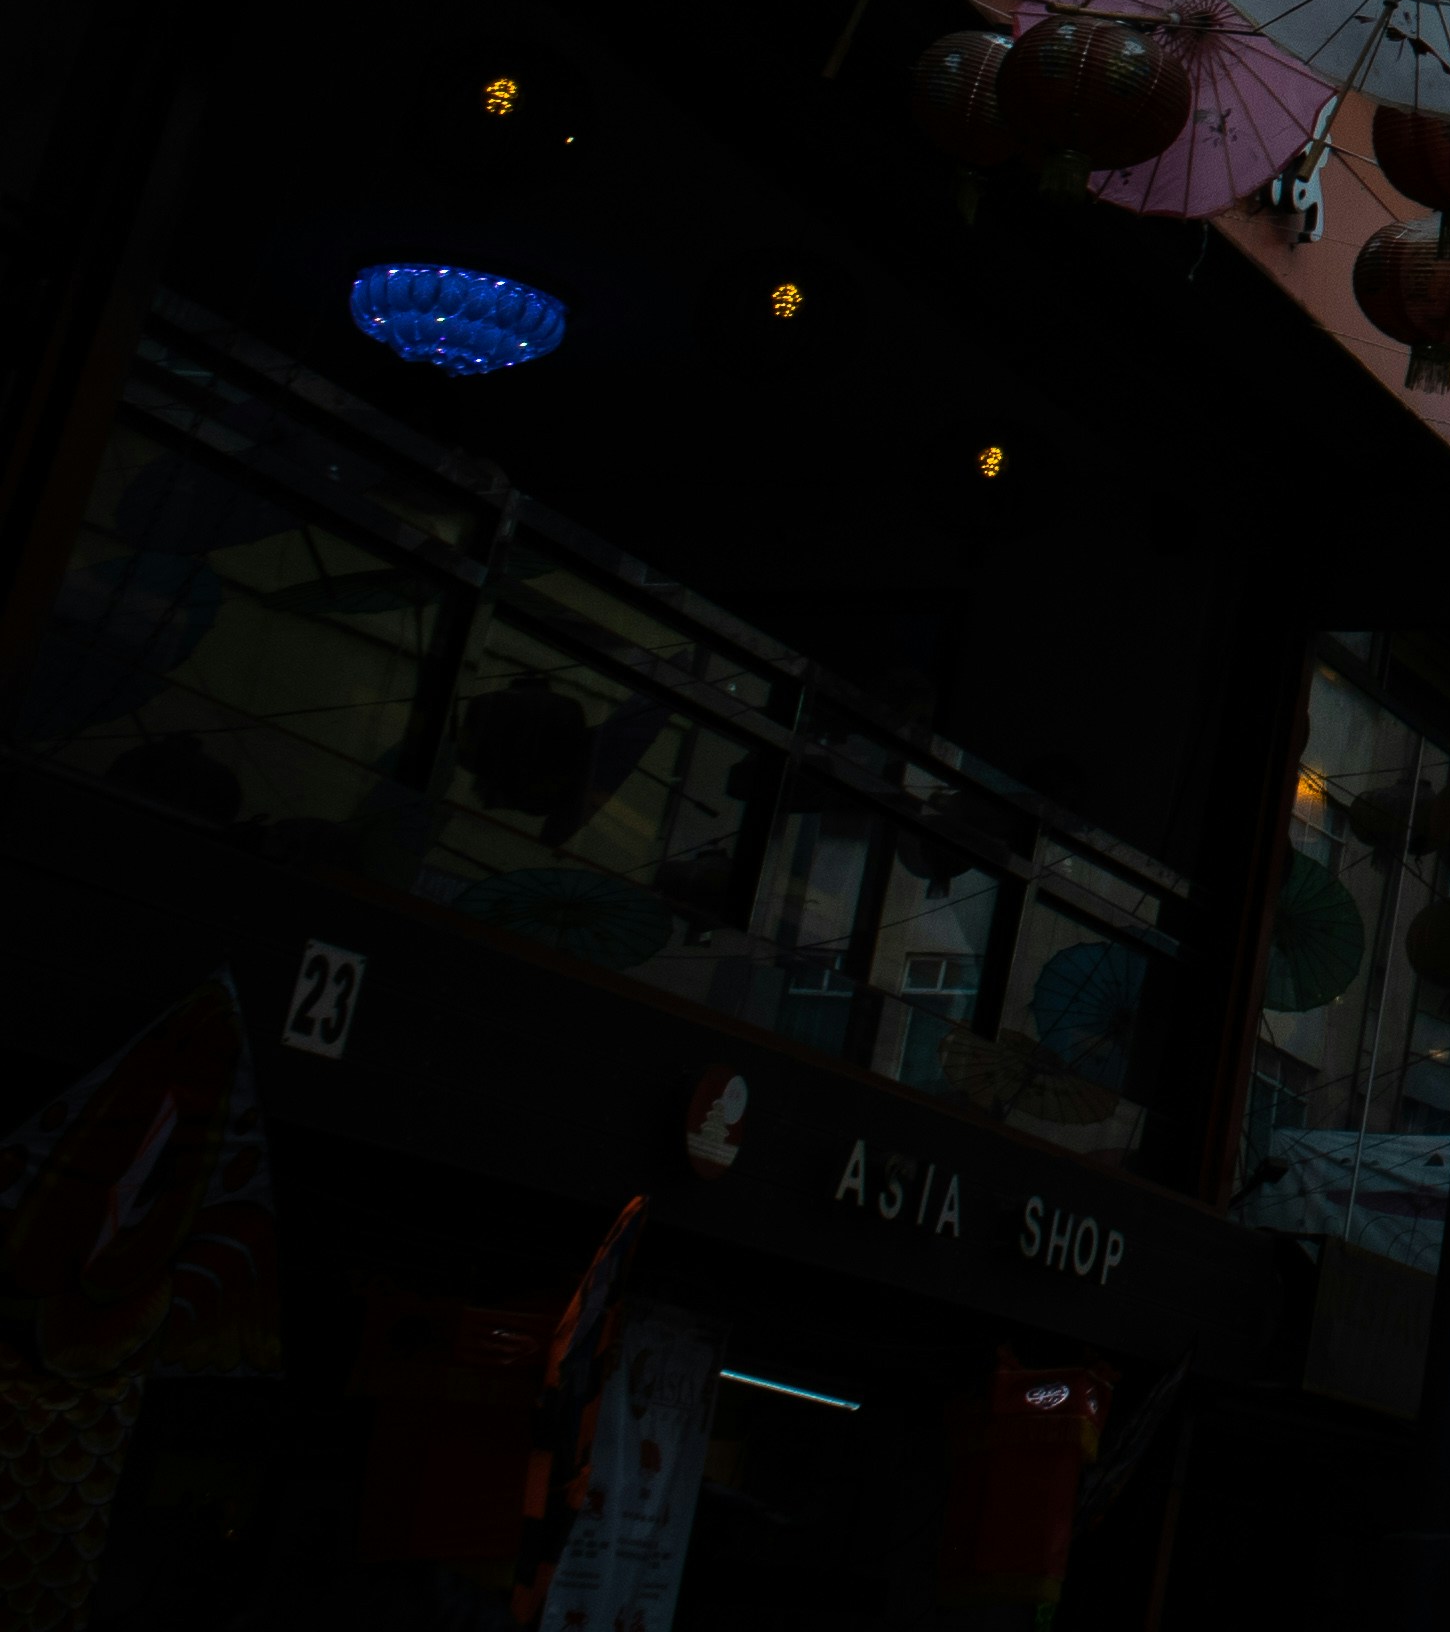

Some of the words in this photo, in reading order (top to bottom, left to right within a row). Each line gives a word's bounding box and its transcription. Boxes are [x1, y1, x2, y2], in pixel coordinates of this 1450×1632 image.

[291, 955, 356, 1047] 23
[835, 1138, 963, 1240] ASIA
[1017, 1193, 1126, 1287] SHOP
